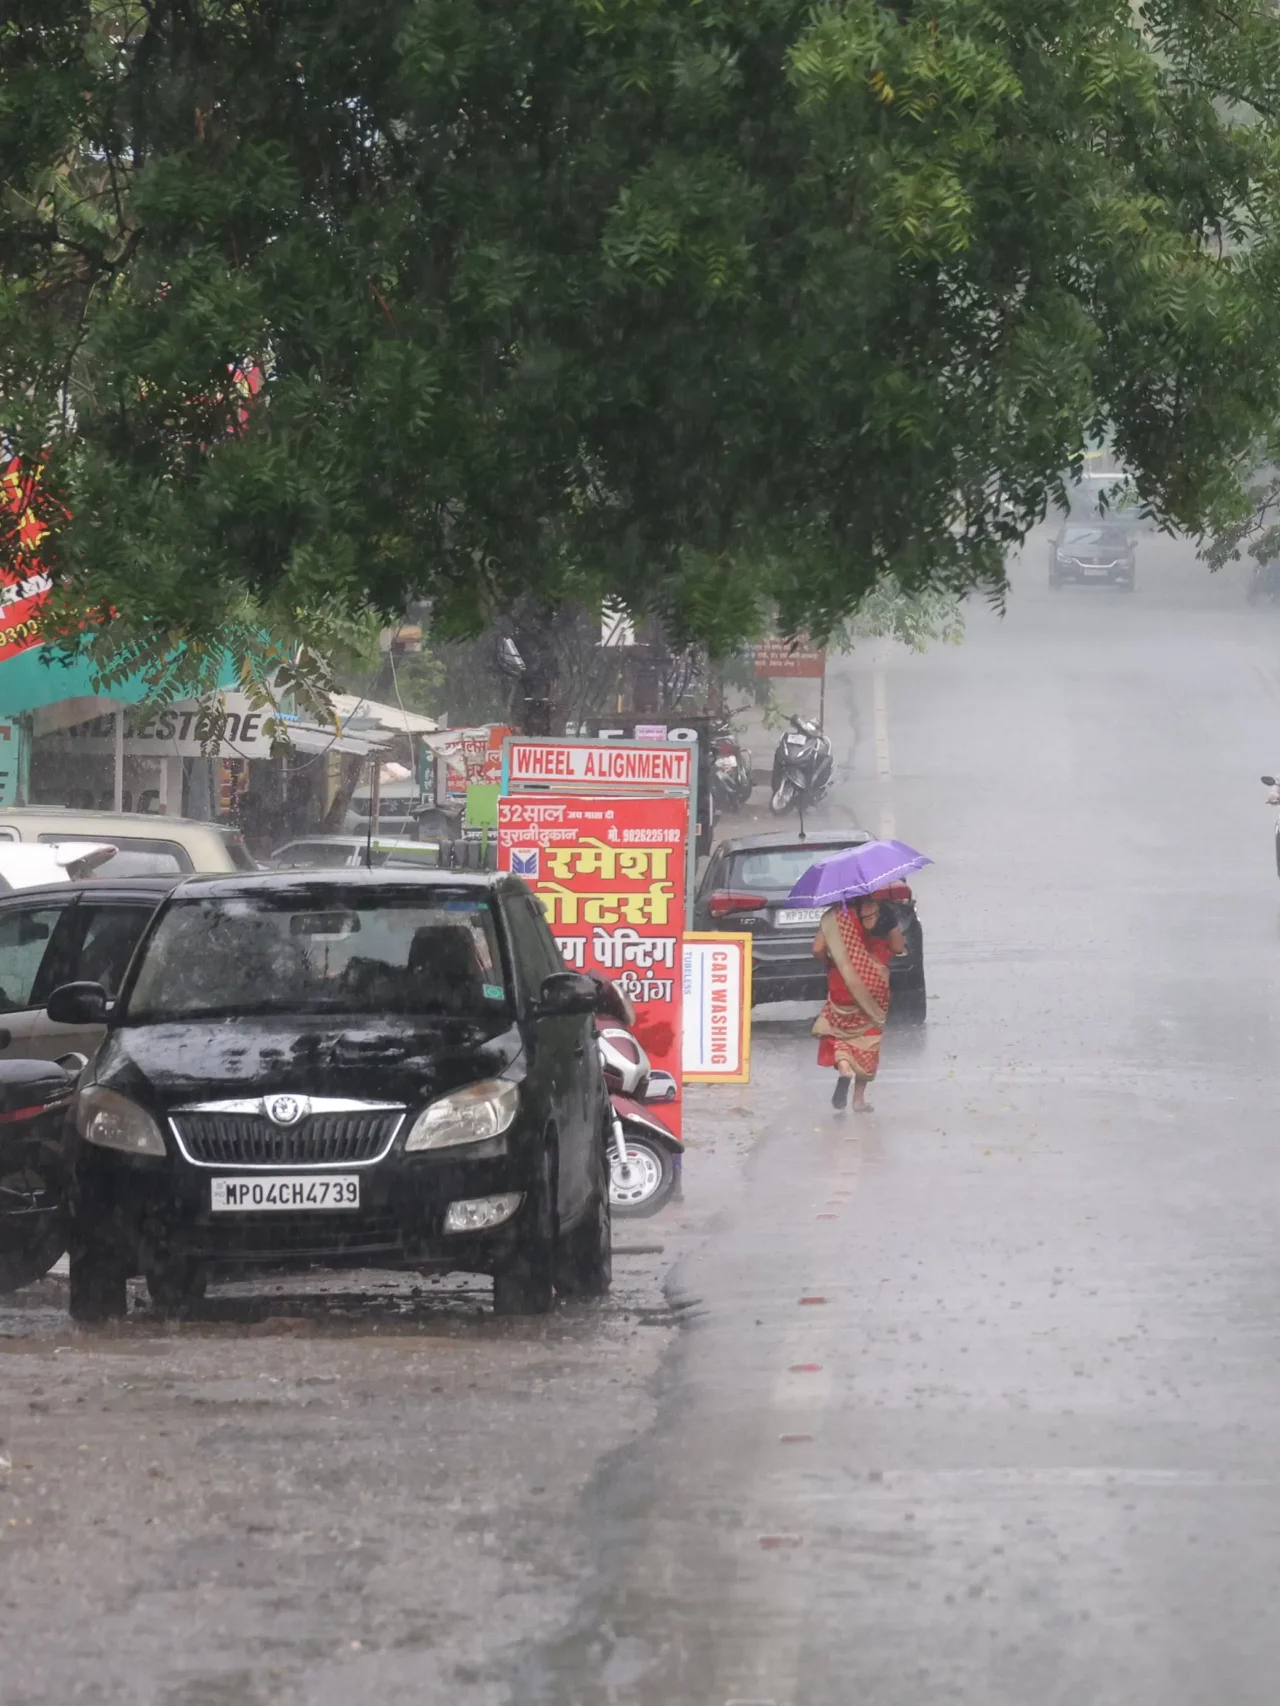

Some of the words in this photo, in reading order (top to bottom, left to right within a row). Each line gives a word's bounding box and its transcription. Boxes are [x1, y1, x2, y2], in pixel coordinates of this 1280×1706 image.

[517, 748, 575, 775] WHEEL
[584, 752, 684, 779] ALIGNMENT
[622, 828, 681, 843] 9826225182
[544, 837, 674, 880] रमेश
[683, 951, 693, 995] TUBELESS
[711, 951, 727, 984] CAR
[711, 988, 727, 1065] WASHING
[225, 1182, 358, 1205] MP04CH4739
